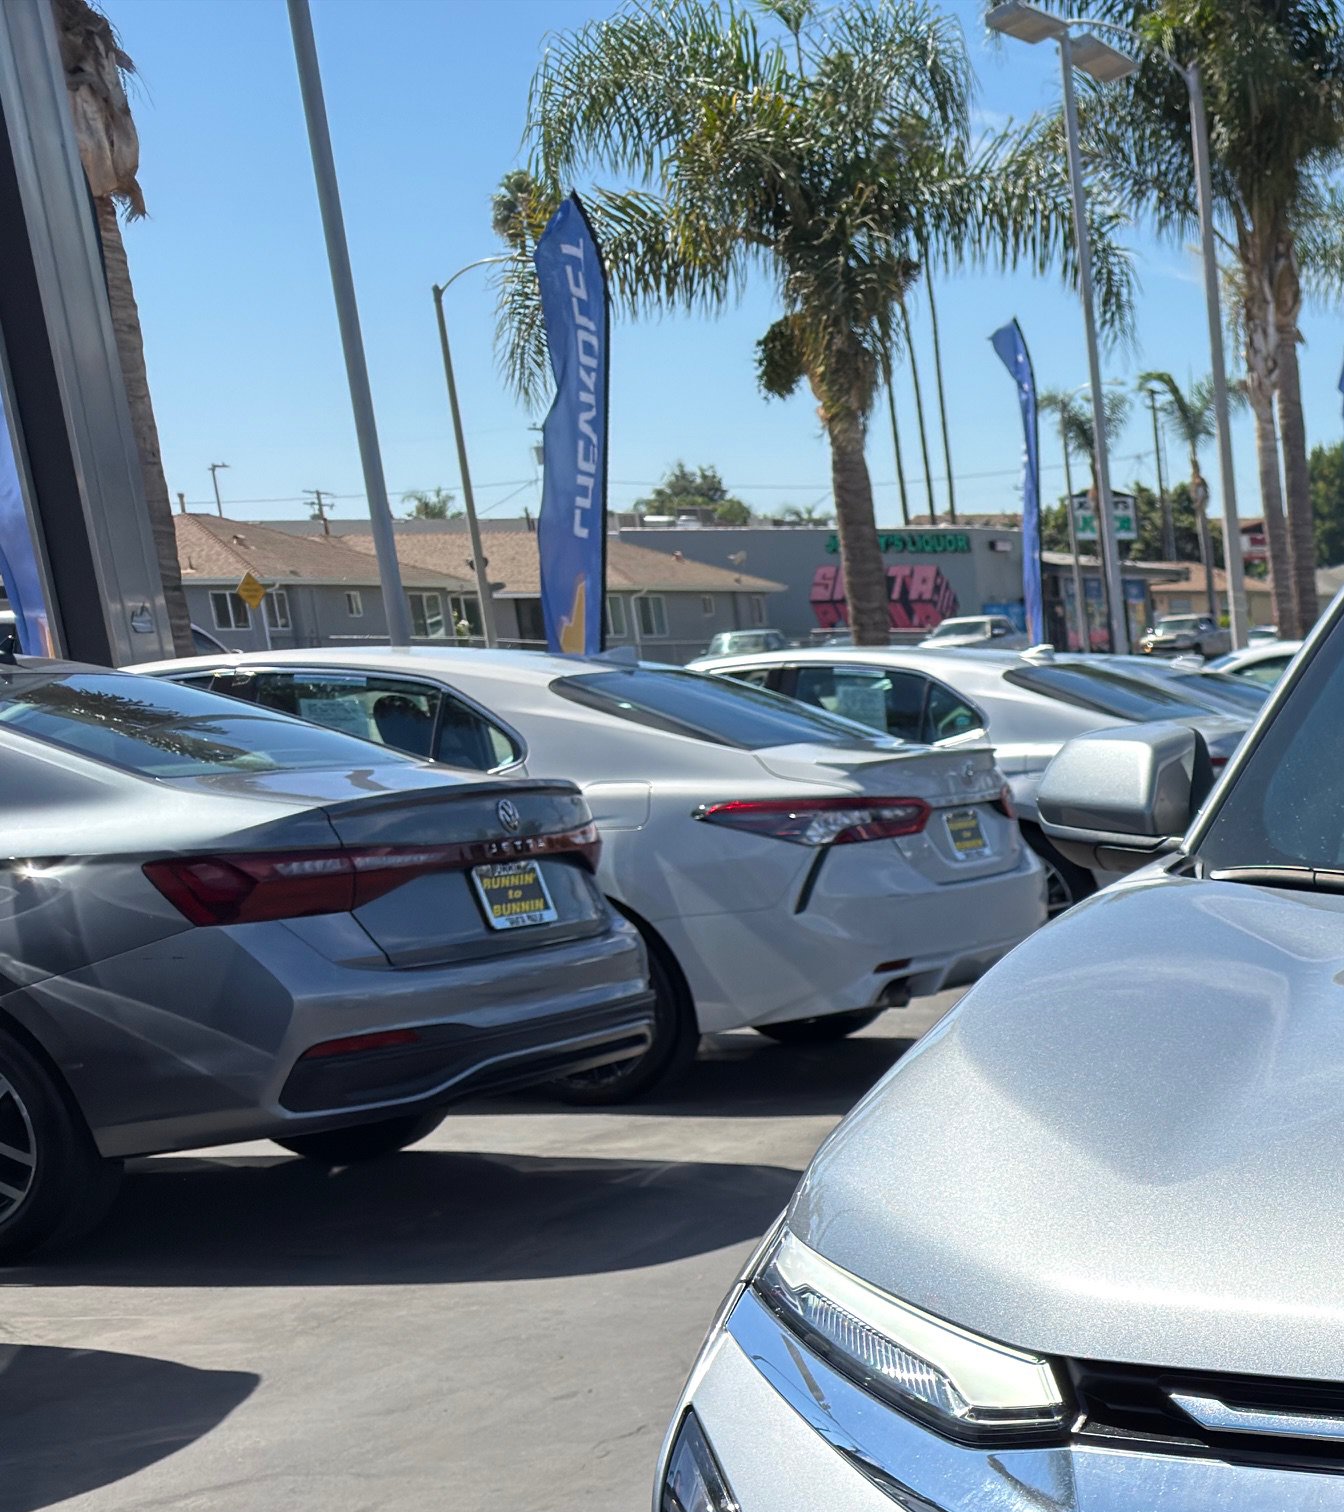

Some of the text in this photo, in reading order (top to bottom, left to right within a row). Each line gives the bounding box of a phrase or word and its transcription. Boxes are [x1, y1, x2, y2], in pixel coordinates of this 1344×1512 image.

[906, 534, 971, 553] LIQUOR
[508, 889, 522, 900] to
[493, 898, 545, 917] BUNNIN
